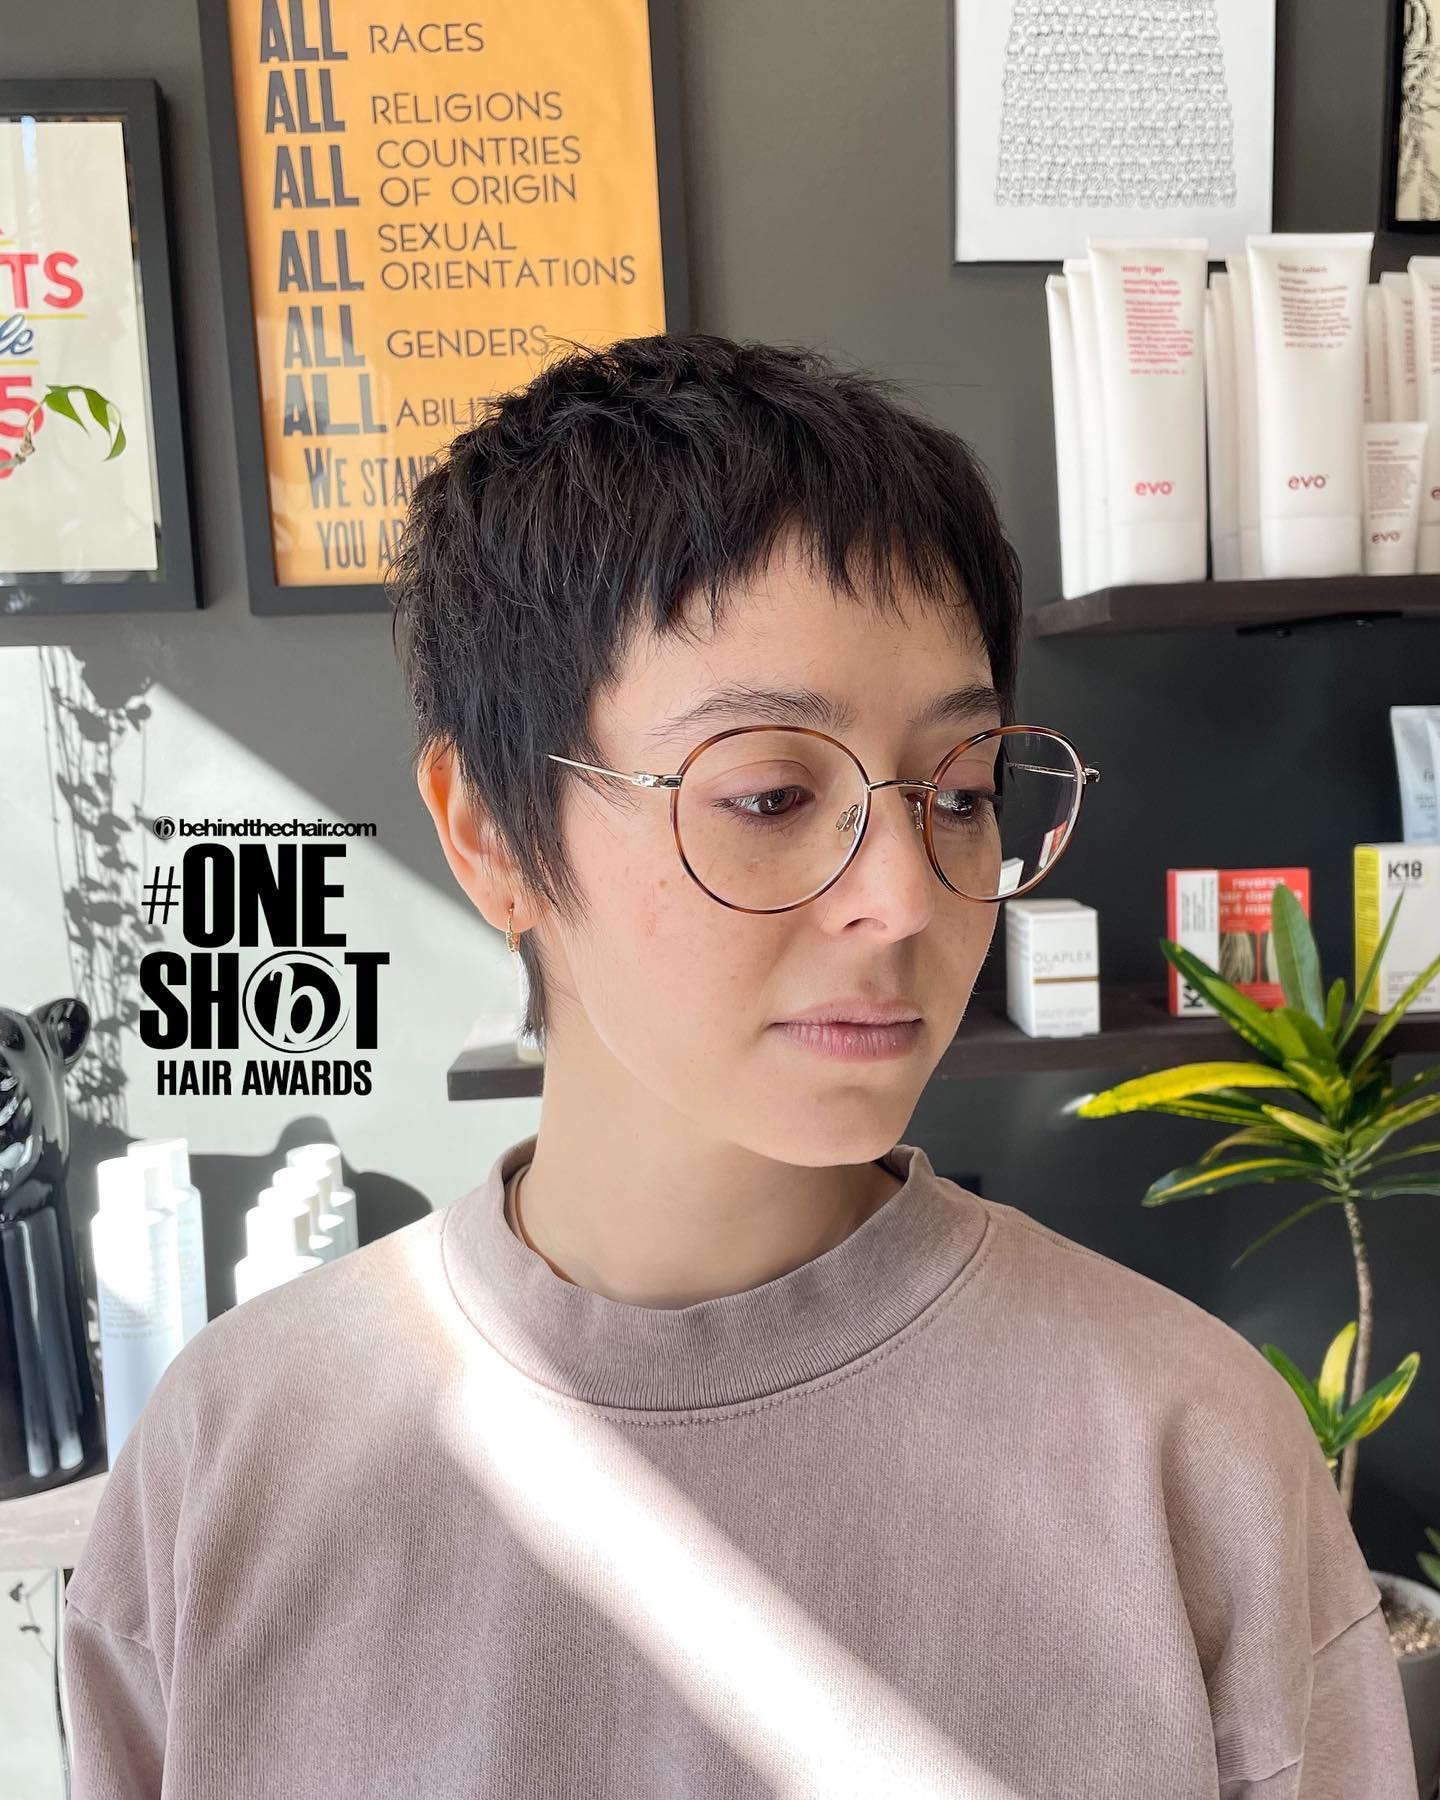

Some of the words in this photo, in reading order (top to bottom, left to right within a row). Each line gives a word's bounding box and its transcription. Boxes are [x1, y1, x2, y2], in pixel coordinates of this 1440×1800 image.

[260, 0, 348, 63] ALL
[368, 23, 484, 53] RACES
[265, 69, 345, 133] ALL
[372, 91, 563, 125] RELIGIONS
[273, 145, 360, 209] ALL
[377, 135, 580, 168] COUNTRIES
[380, 177, 432, 206] OF
[451, 174, 576, 205] ORIGIN
[278, 230, 365, 292] ALL
[377, 222, 518, 252] SEXUAL
[381, 256, 636, 290] ORIENTATIONS
[284, 304, 366, 368] ALL
[386, 325, 550, 358] GENDERS
[283, 373, 387, 436] ALL
[1135, 480, 1173, 496] evo
[1288, 475, 1326, 489] evo
[317, 520, 366, 570] YOU
[1371, 531, 1401, 544] evo
[1387, 861, 1423, 879] K18
